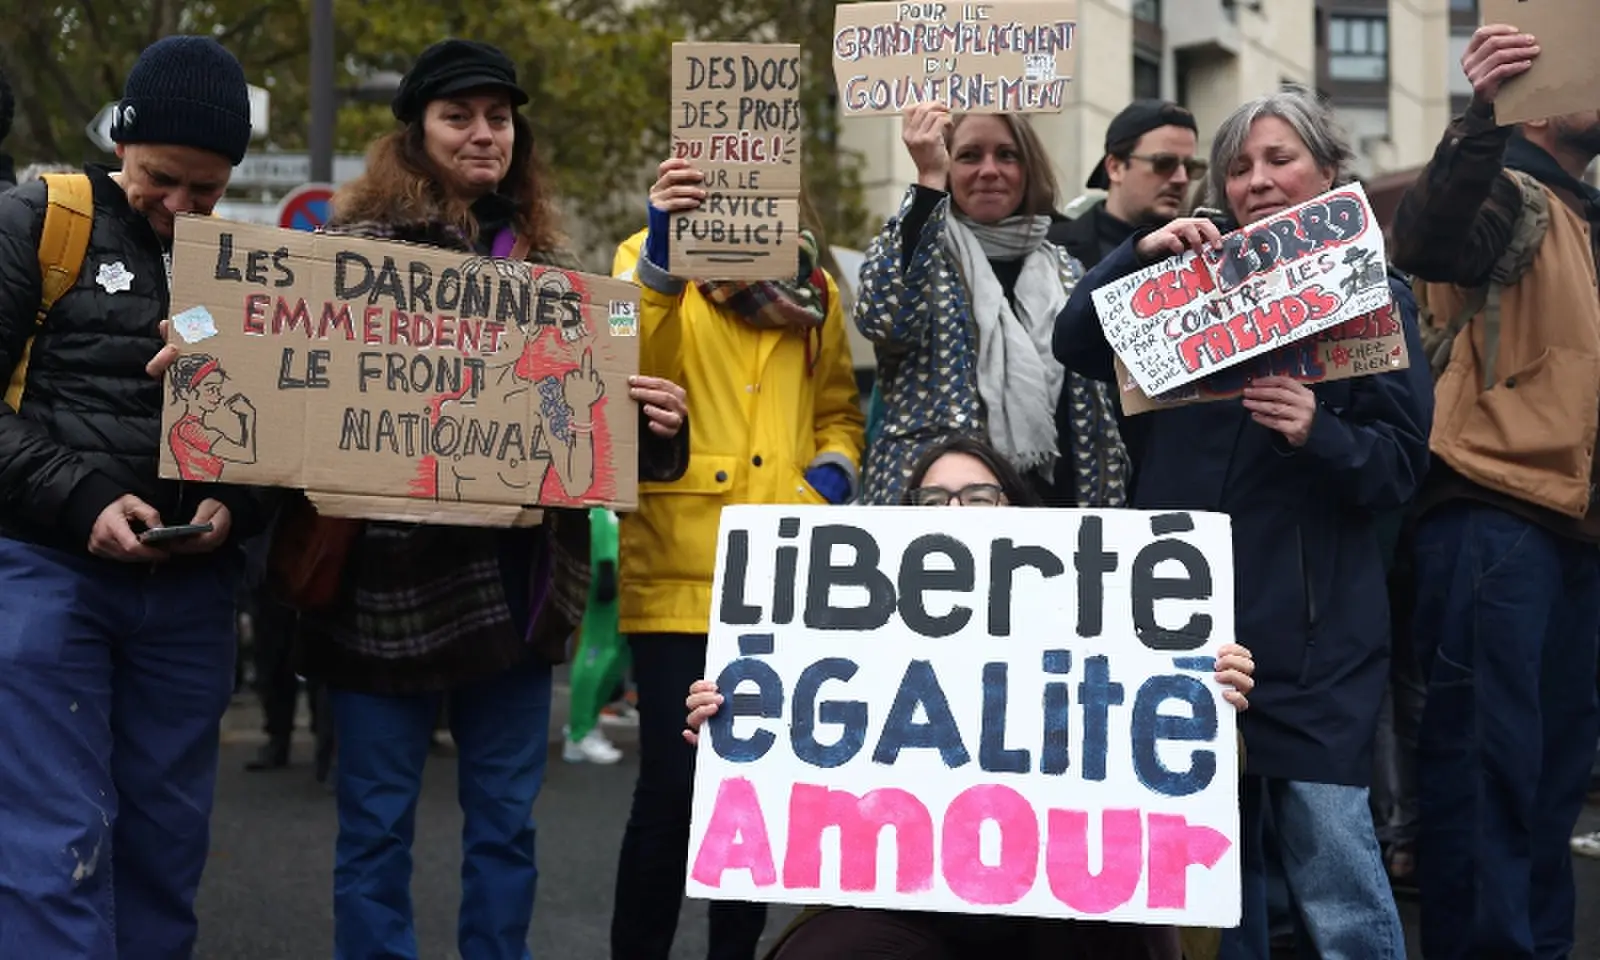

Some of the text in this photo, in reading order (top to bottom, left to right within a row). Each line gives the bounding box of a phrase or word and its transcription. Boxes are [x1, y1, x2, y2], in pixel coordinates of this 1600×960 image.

[898, 4, 993, 22] POUR LE
[686, 56, 800, 92] DES DOCS
[925, 58, 957, 74] DU
[845, 74, 1072, 111] GOUVERNEMENT
[678, 97, 800, 131] DES PROFS
[739, 170, 760, 189] LE
[215, 233, 582, 328] LES DARONNES
[243, 294, 507, 355] EMMERDENT
[1164, 279, 1272, 338] CONTRE
[1176, 284, 1343, 373] FACHOS
[277, 347, 487, 398] LE FRONT
